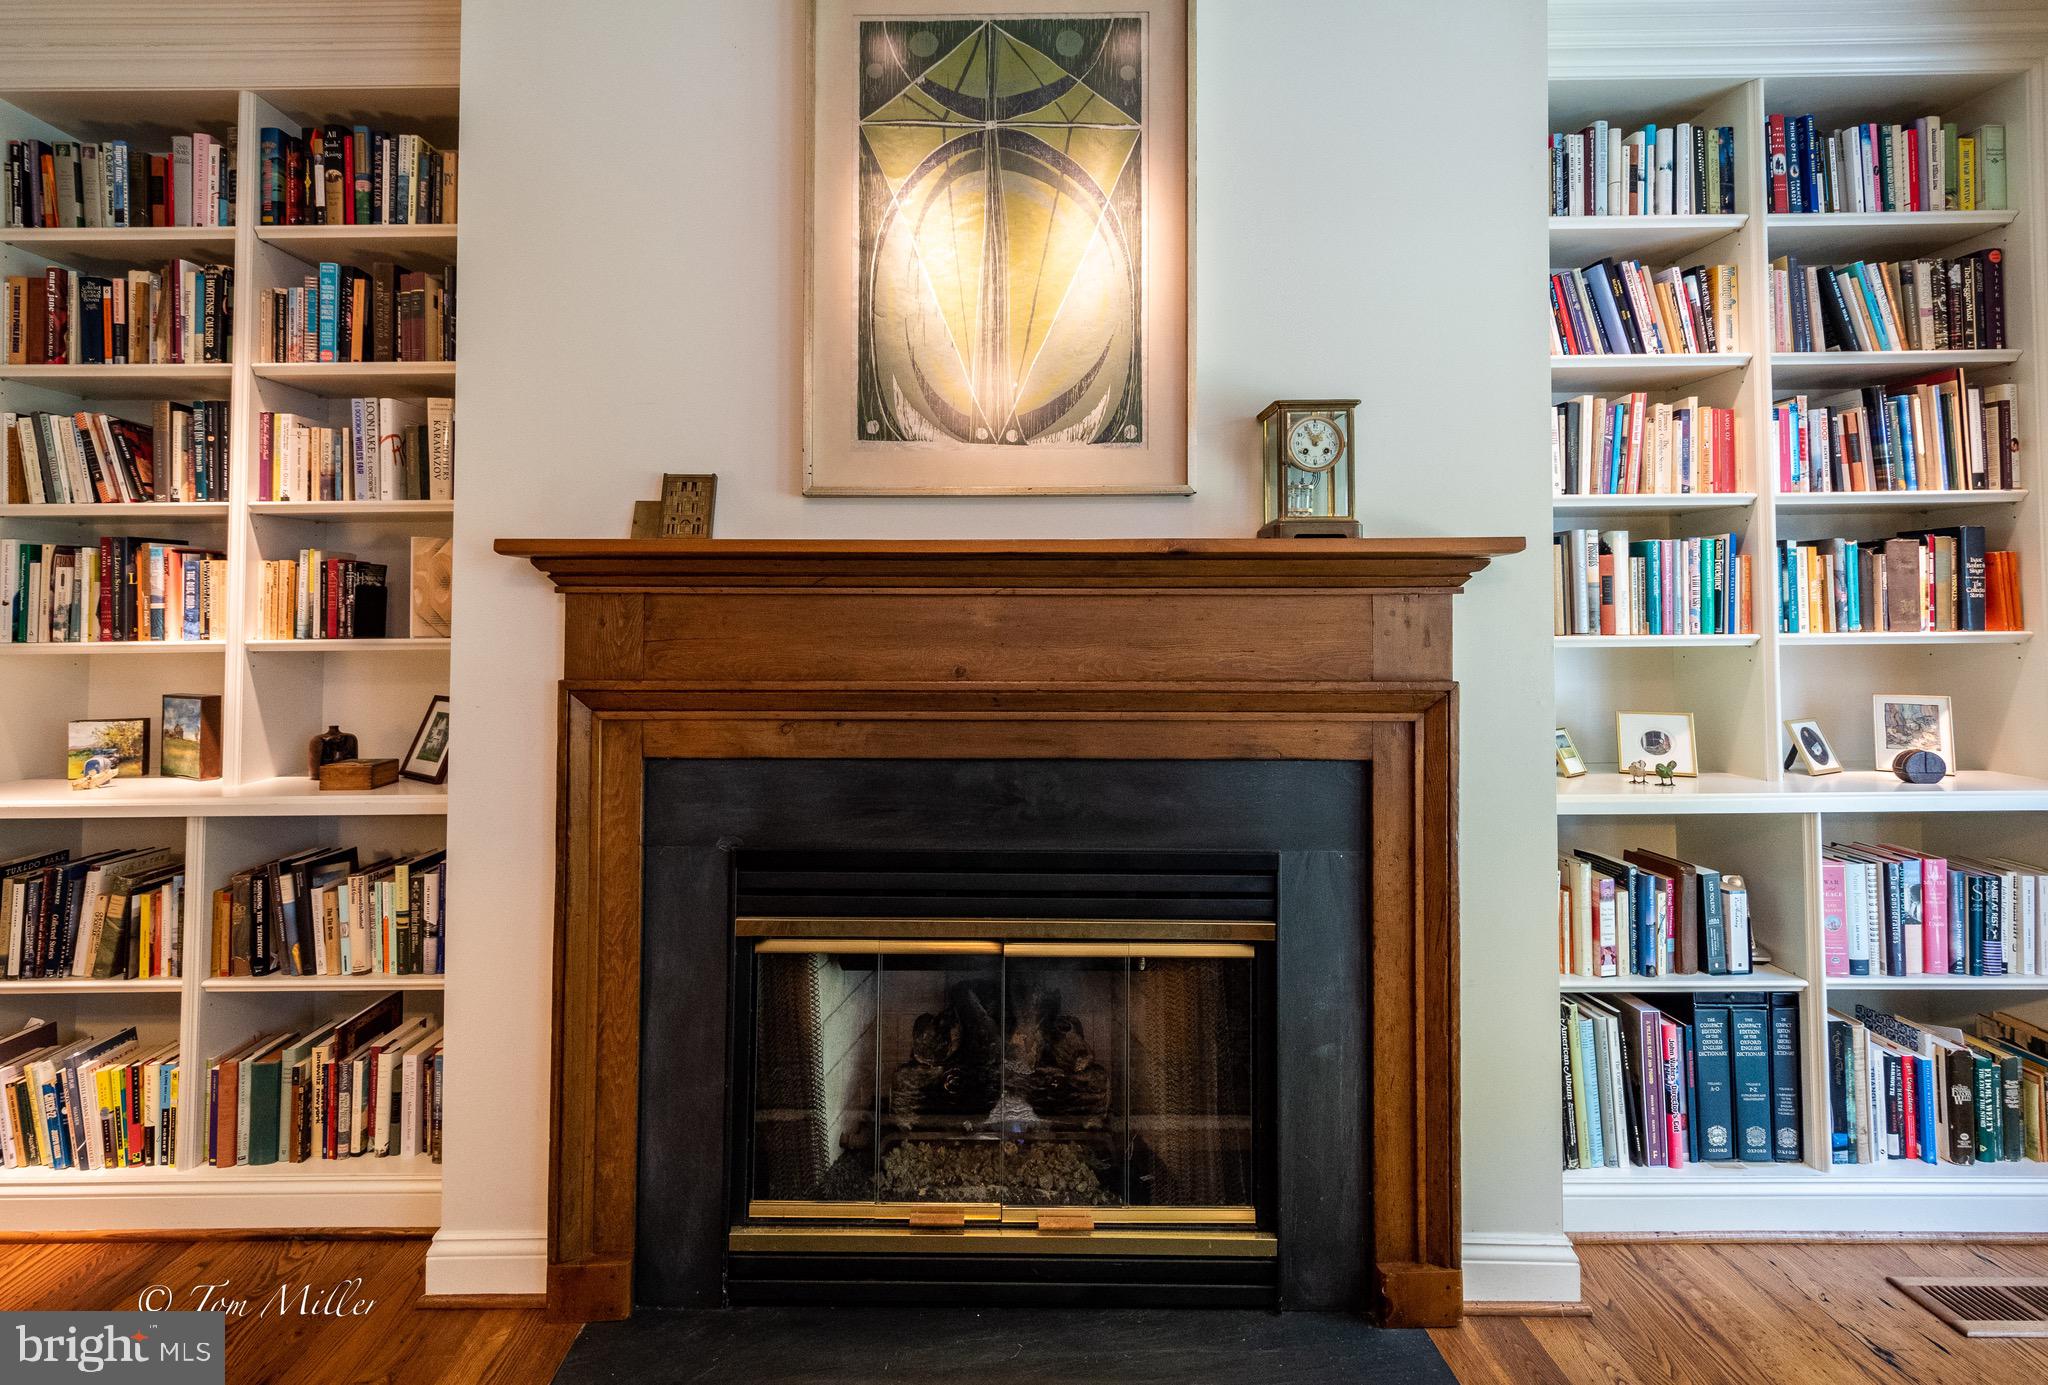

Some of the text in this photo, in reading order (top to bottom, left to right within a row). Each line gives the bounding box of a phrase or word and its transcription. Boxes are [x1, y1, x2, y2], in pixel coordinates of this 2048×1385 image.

[1791, 153, 1797, 162] ME
[47, 271, 56, 293] mary
[1963, 279, 1972, 304] Beggar
[47, 293, 58, 312] jane
[205, 280, 215, 348] HORTENSE CALISHER
[1701, 282, 1711, 310] McEWAN
[1706, 317, 1715, 342] Nutshell
[366, 401, 375, 427] LOON
[367, 428, 376, 453] LAKE
[433, 420, 441, 481] KARAMAZOV
[1714, 559, 1723, 591] Foreigner
[1891, 893, 1899, 944] Considerations
[1991, 902, 1998, 911] AT
[48, 914, 59, 959] Collected Stories
[1560, 1019, 1574, 1100] American Album
[1669, 1057, 1677, 1081] Waters
[1671, 1085, 1679, 1119] Director's
[1906, 1077, 1914, 1113] Confections
[1984, 1068, 1993, 1133] EUDORA WELTY
[146, 1104, 154, 1124] good
